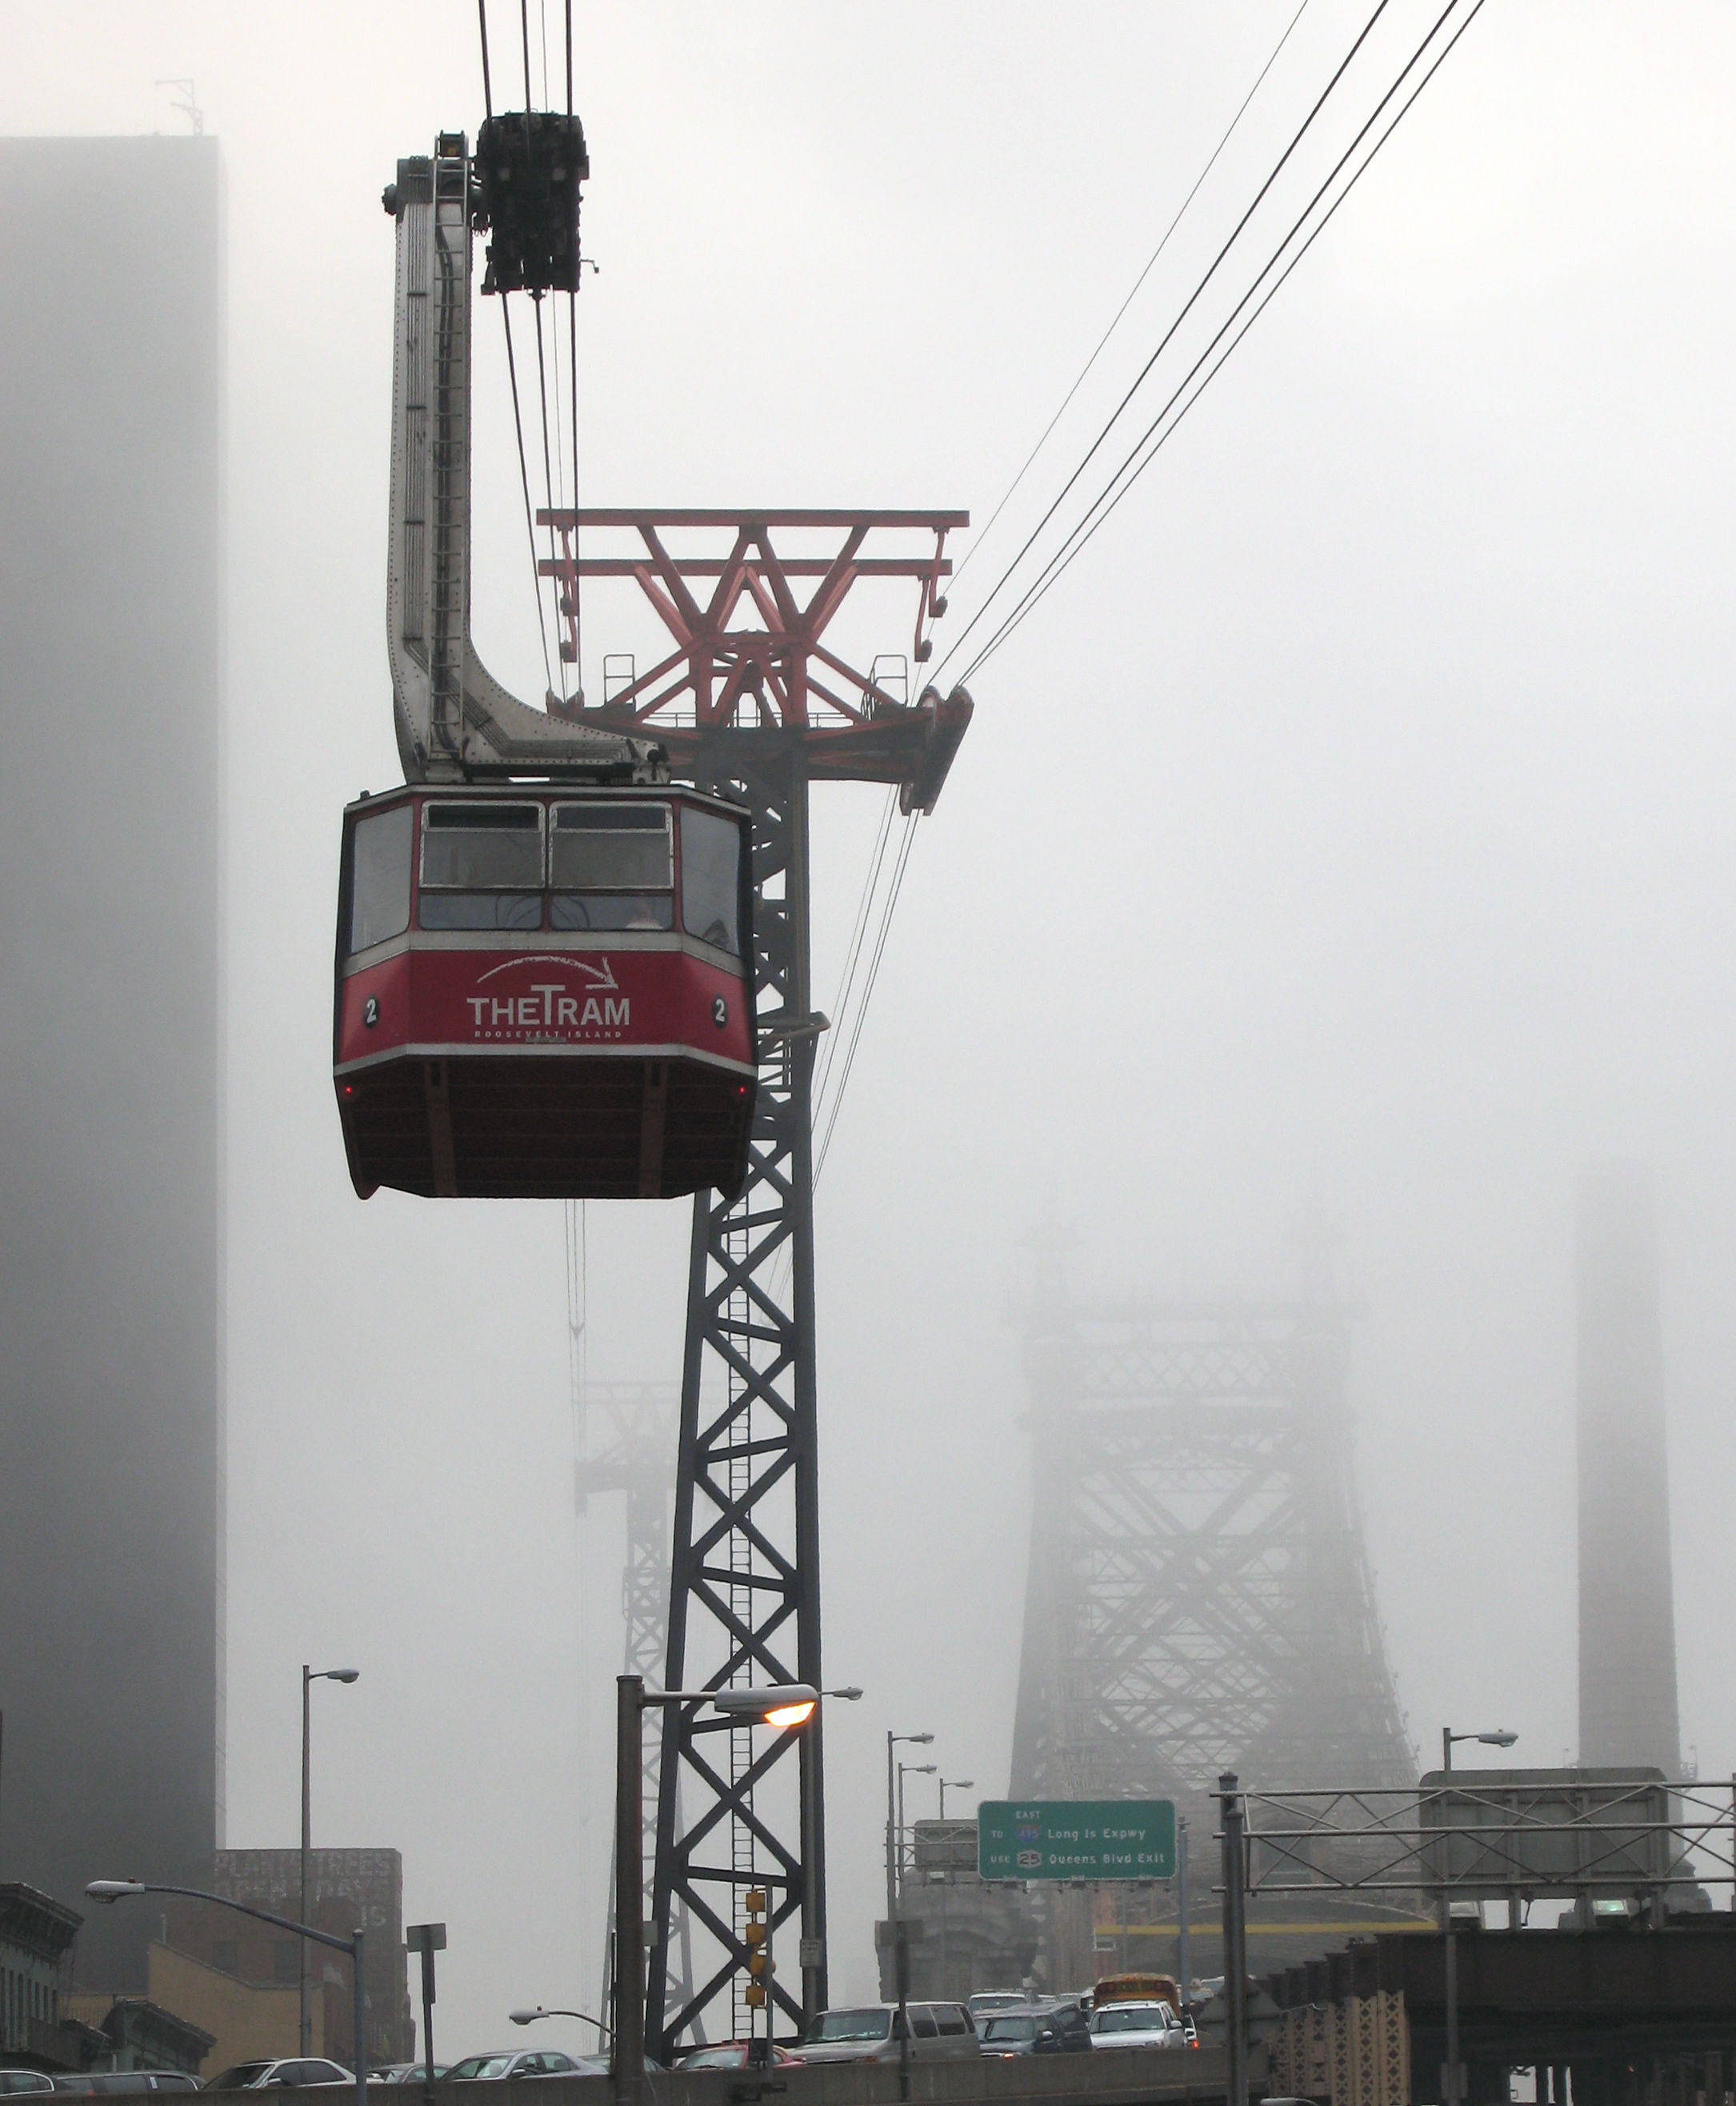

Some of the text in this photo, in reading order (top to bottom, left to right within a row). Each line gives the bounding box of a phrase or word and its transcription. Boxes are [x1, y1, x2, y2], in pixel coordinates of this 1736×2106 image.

[366, 999, 377, 1023] 2
[715, 999, 725, 1022] 2
[1016, 1811, 1041, 1819] EAST
[992, 1830, 1003, 1838] TO
[1048, 1828, 1078, 1841] Long
[1085, 1828, 1096, 1838] Is
[1104, 1828, 1146, 1840] Expwy
[312, 1852, 391, 1876] TREES
[991, 1853, 1165, 1864] USE 25 Queens Blvd Exit
